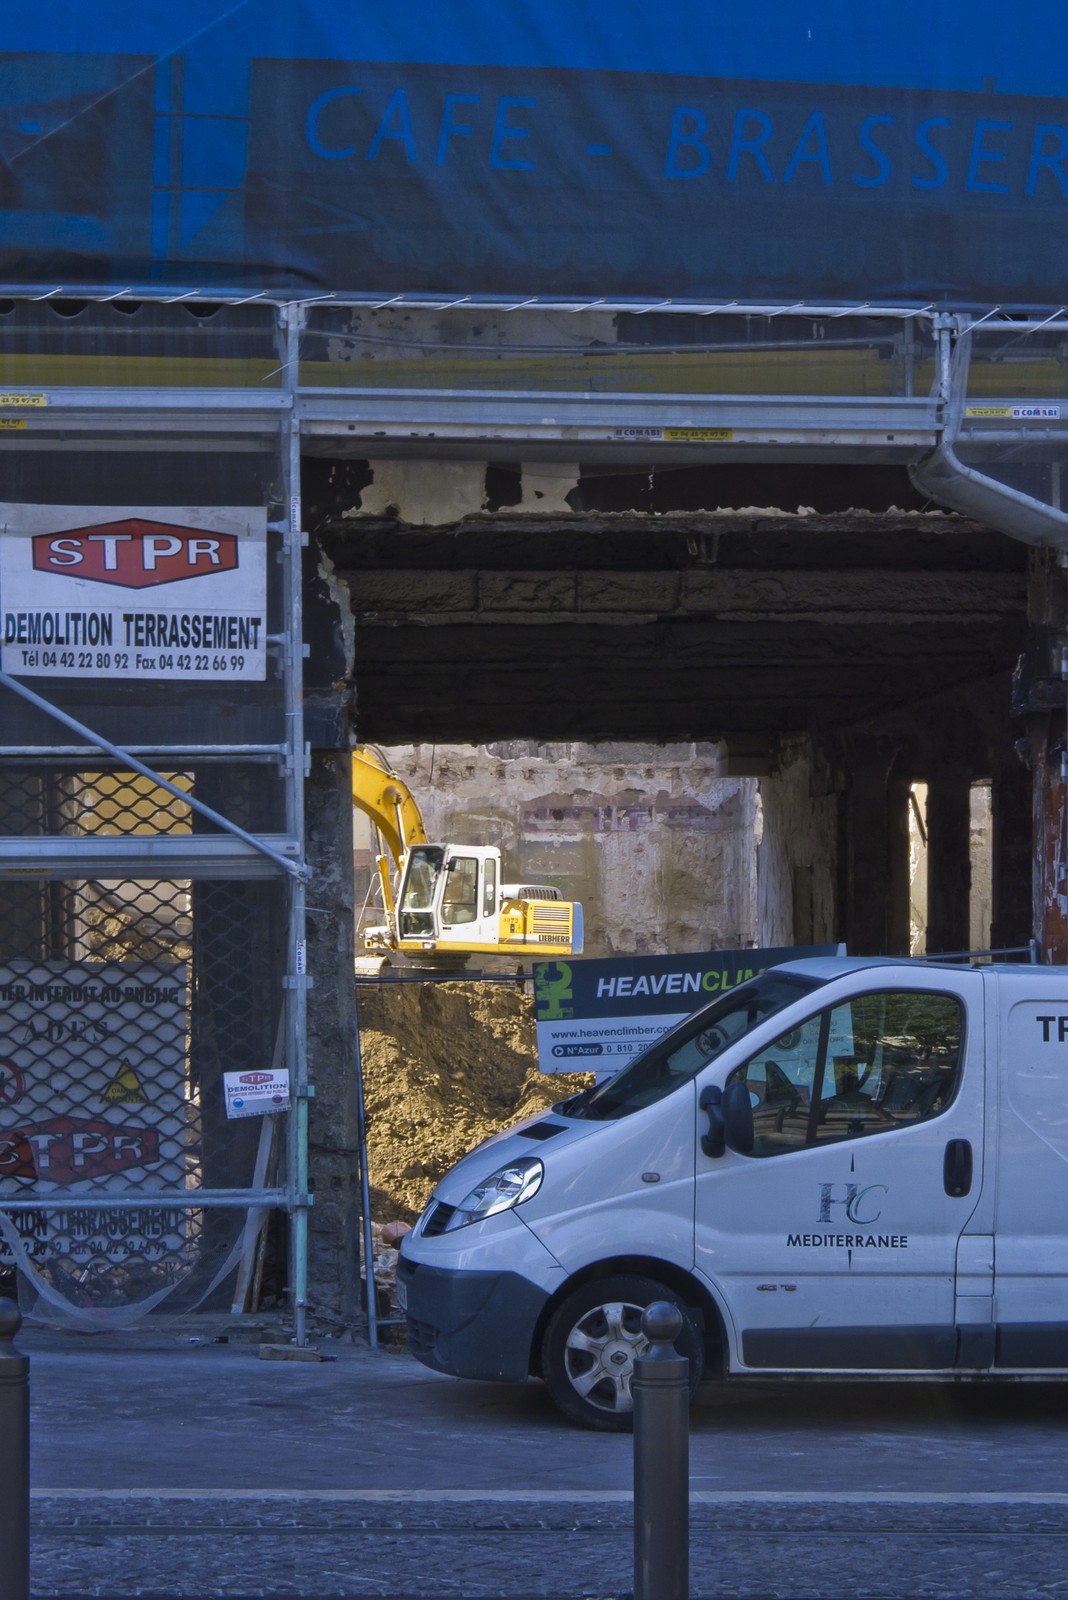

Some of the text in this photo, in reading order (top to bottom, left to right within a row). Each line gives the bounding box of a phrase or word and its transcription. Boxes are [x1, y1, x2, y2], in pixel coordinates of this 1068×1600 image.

[305, 84, 538, 171] CAFE
[664, 105, 1068, 197] BRASSER
[48, 534, 222, 571] STPR
[5, 612, 261, 649] DEMOLITION TERRASSEMENT
[22, 650, 245, 671] Tél 04 42 22 80 92 Fax 04 42 22 66 99
[538, 935, 570, 943] LIEBHERR
[606, 1045, 612, 1053] 0
[617, 1044, 633, 1052] 810
[228, 1084, 286, 1092] DEMOLITION
[787, 1234, 908, 1248] MEDITERRANEE
